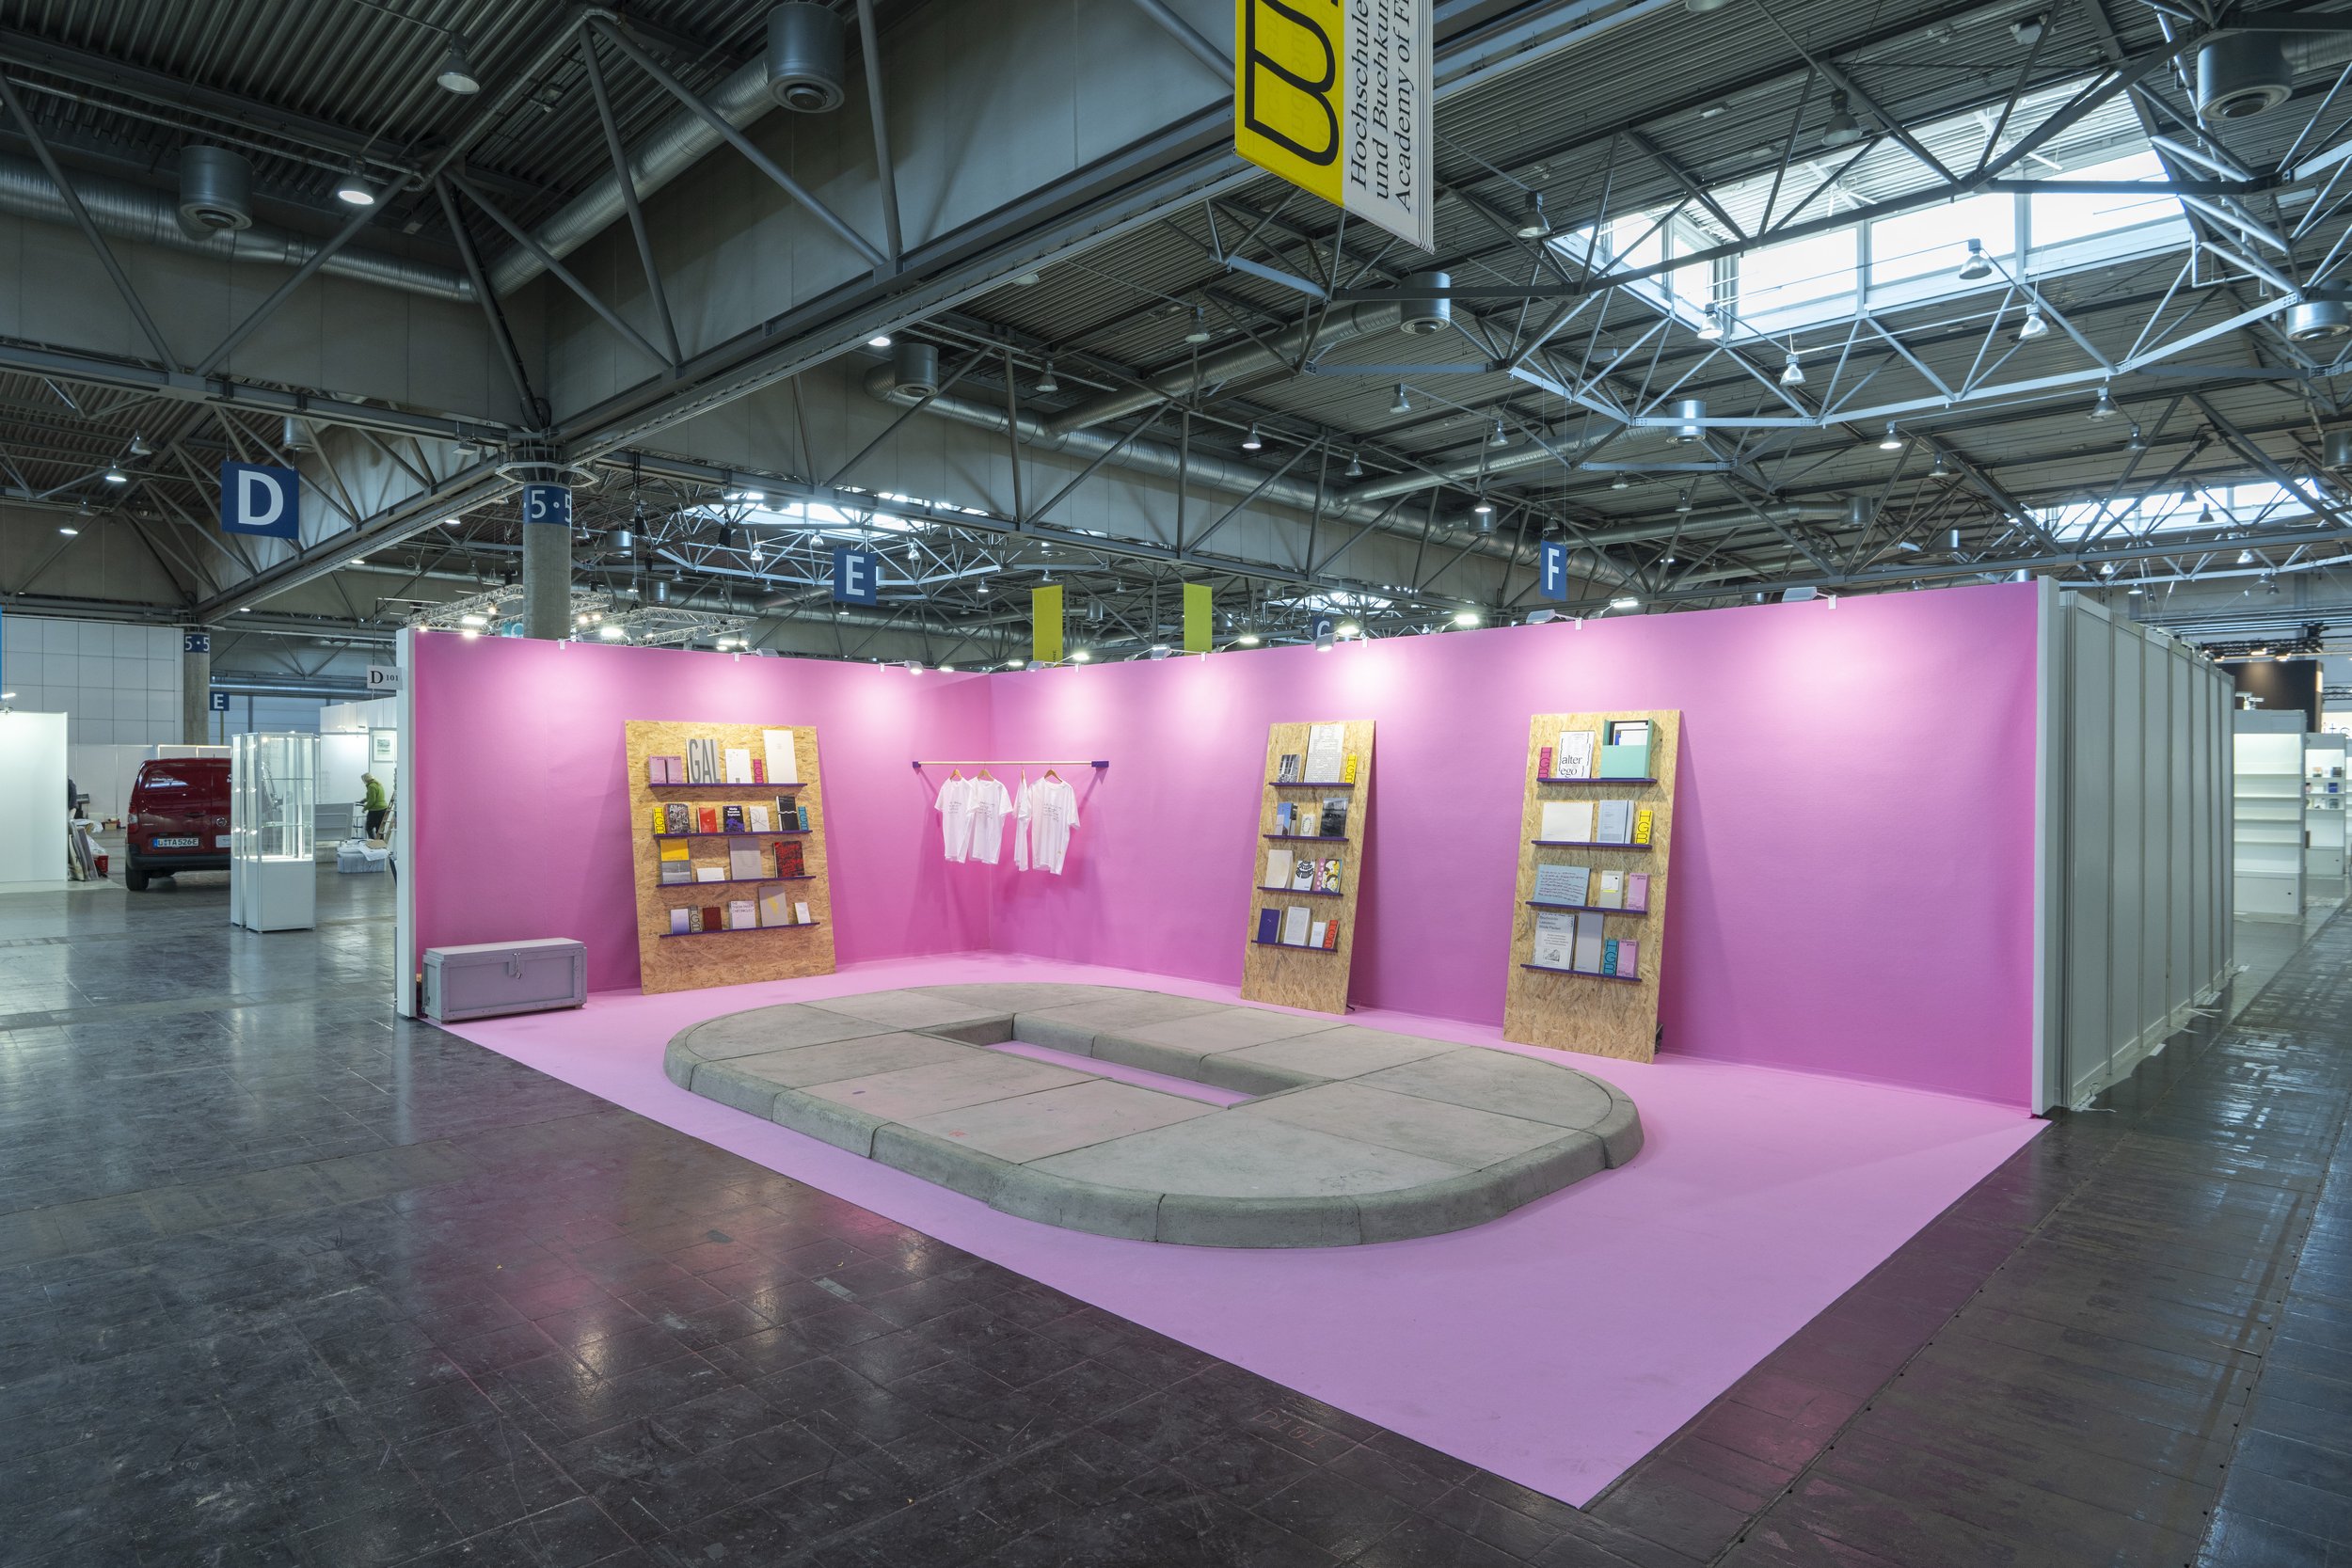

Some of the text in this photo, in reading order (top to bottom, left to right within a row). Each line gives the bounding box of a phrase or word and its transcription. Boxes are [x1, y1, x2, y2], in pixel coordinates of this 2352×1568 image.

[1393, 26, 1411, 64] of
[1394, 69, 1415, 214] Academy
[1372, 137, 1390, 200] und
[238, 469, 284, 526] D
[531, 489, 546, 519] 5
[846, 555, 865, 596] E
[1548, 547, 1560, 591] F
[184, 636, 211, 652] 5 5
[370, 671, 384, 685] D
[214, 693, 224, 709] E
[1560, 768, 1578, 779] ego
[1562, 754, 1582, 765] alter
